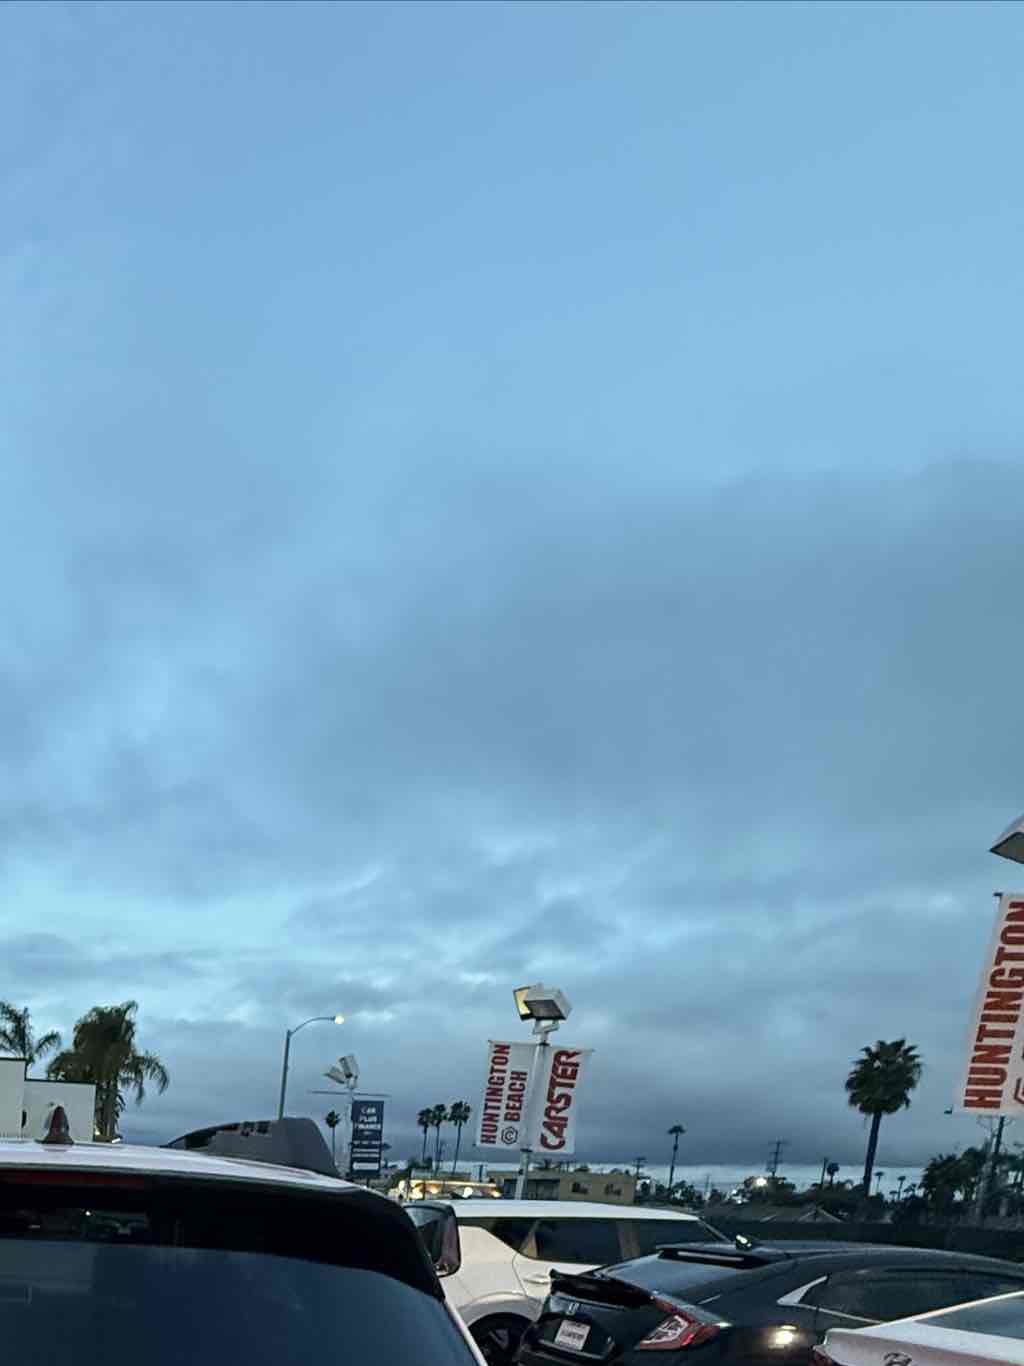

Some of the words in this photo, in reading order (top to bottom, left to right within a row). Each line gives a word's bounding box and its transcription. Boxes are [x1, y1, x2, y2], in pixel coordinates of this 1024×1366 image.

[480, 1044, 511, 1144] HUNTINGTON
[504, 1070, 528, 1122] BEACH
[540, 1049, 582, 1151] CARSTER
